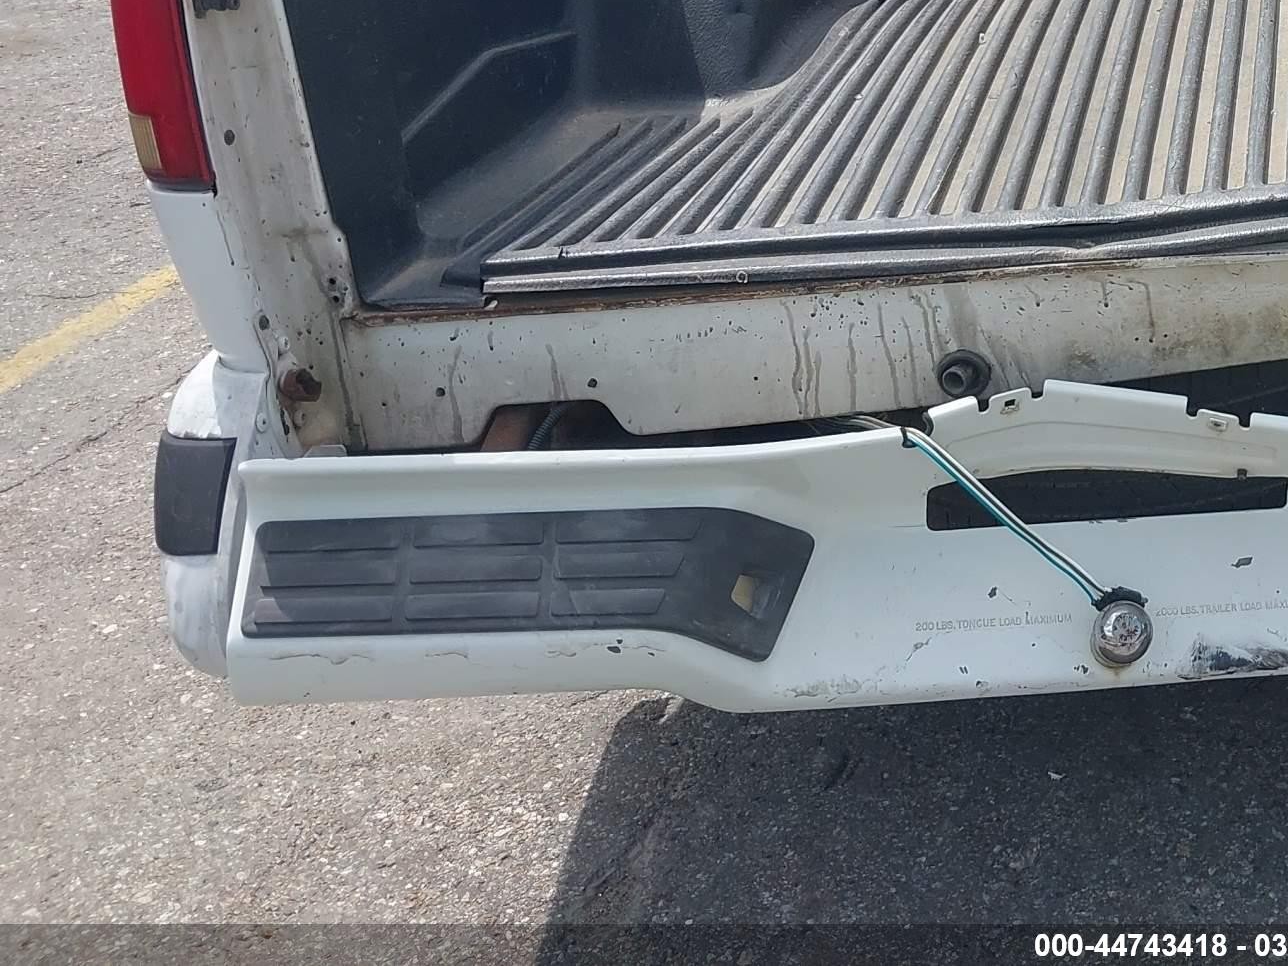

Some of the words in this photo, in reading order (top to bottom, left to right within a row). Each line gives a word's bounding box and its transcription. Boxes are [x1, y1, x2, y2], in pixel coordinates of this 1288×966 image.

[1156, 607, 1179, 617] 2000
[1199, 603, 1237, 614] TRAILER
[1240, 601, 1262, 612] LOAD
[915, 621, 935, 632] 200
[958, 618, 996, 630] TONGUE
[999, 616, 1022, 627] LOAD
[1025, 613, 1073, 625] MAXIMUM
